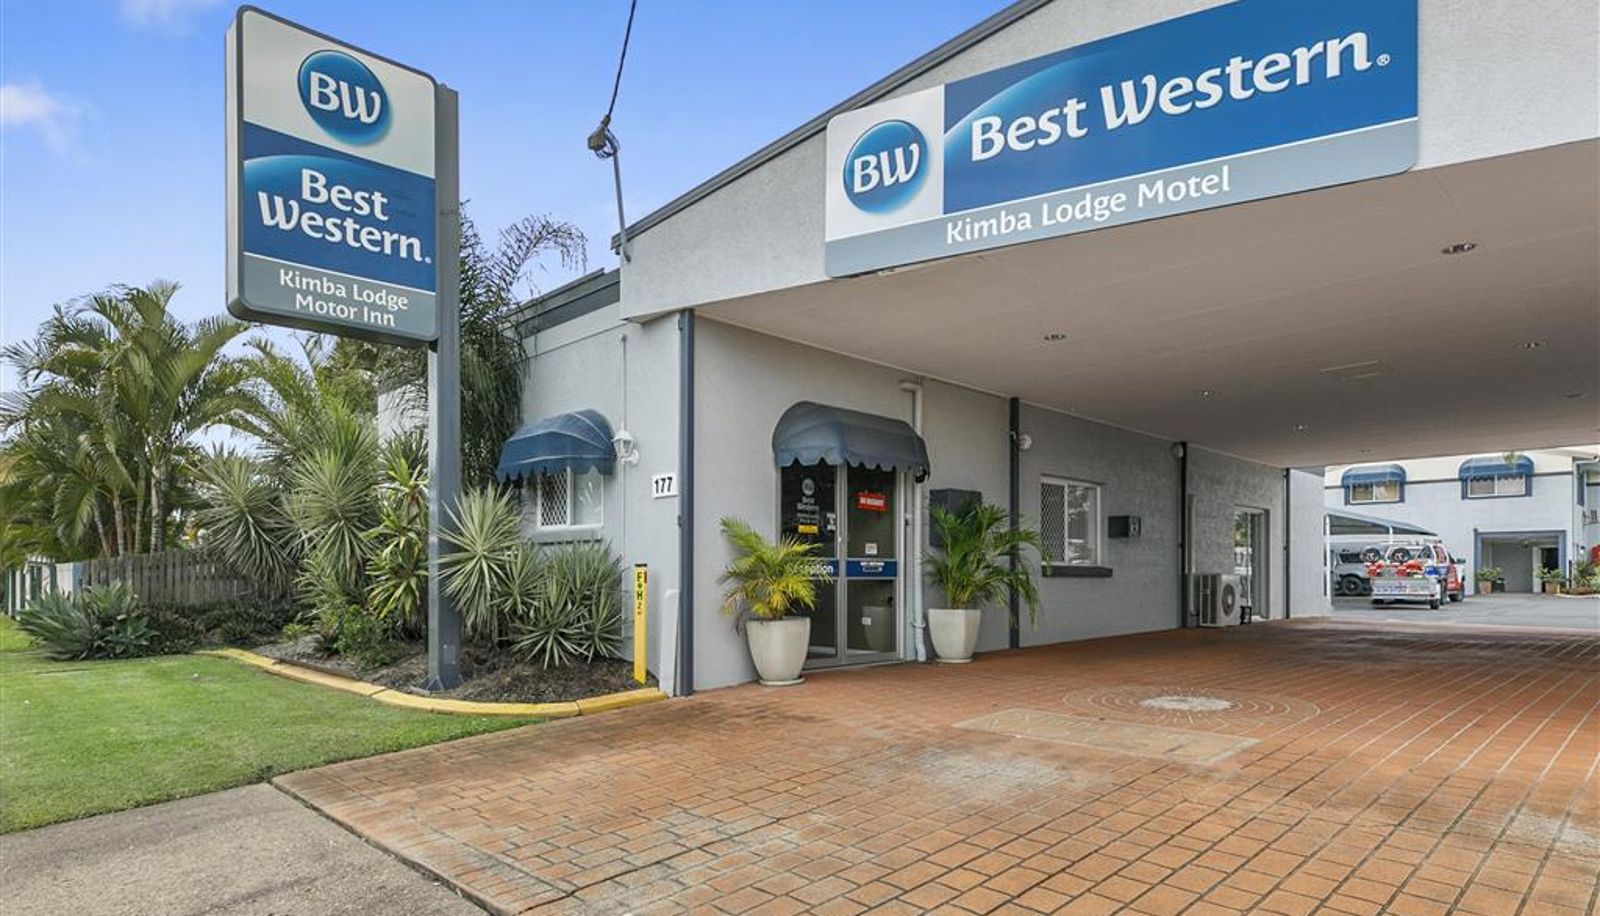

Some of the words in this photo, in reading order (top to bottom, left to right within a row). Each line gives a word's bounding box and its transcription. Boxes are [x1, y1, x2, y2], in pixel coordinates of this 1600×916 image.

[309, 71, 381, 124] BW
[971, 99, 1088, 162] Best
[301, 168, 389, 221] Best
[853, 144, 920, 194] BW
[257, 191, 427, 263] Western
[946, 212, 1033, 245] Kimba
[1042, 192, 1127, 227] Lodge
[1138, 165, 1231, 208] Motel
[279, 268, 347, 298] Kimba
[352, 283, 409, 311] Lodge
[295, 293, 358, 320] Motor
[363, 305, 396, 328] Inn
[654, 476, 674, 494] 177
